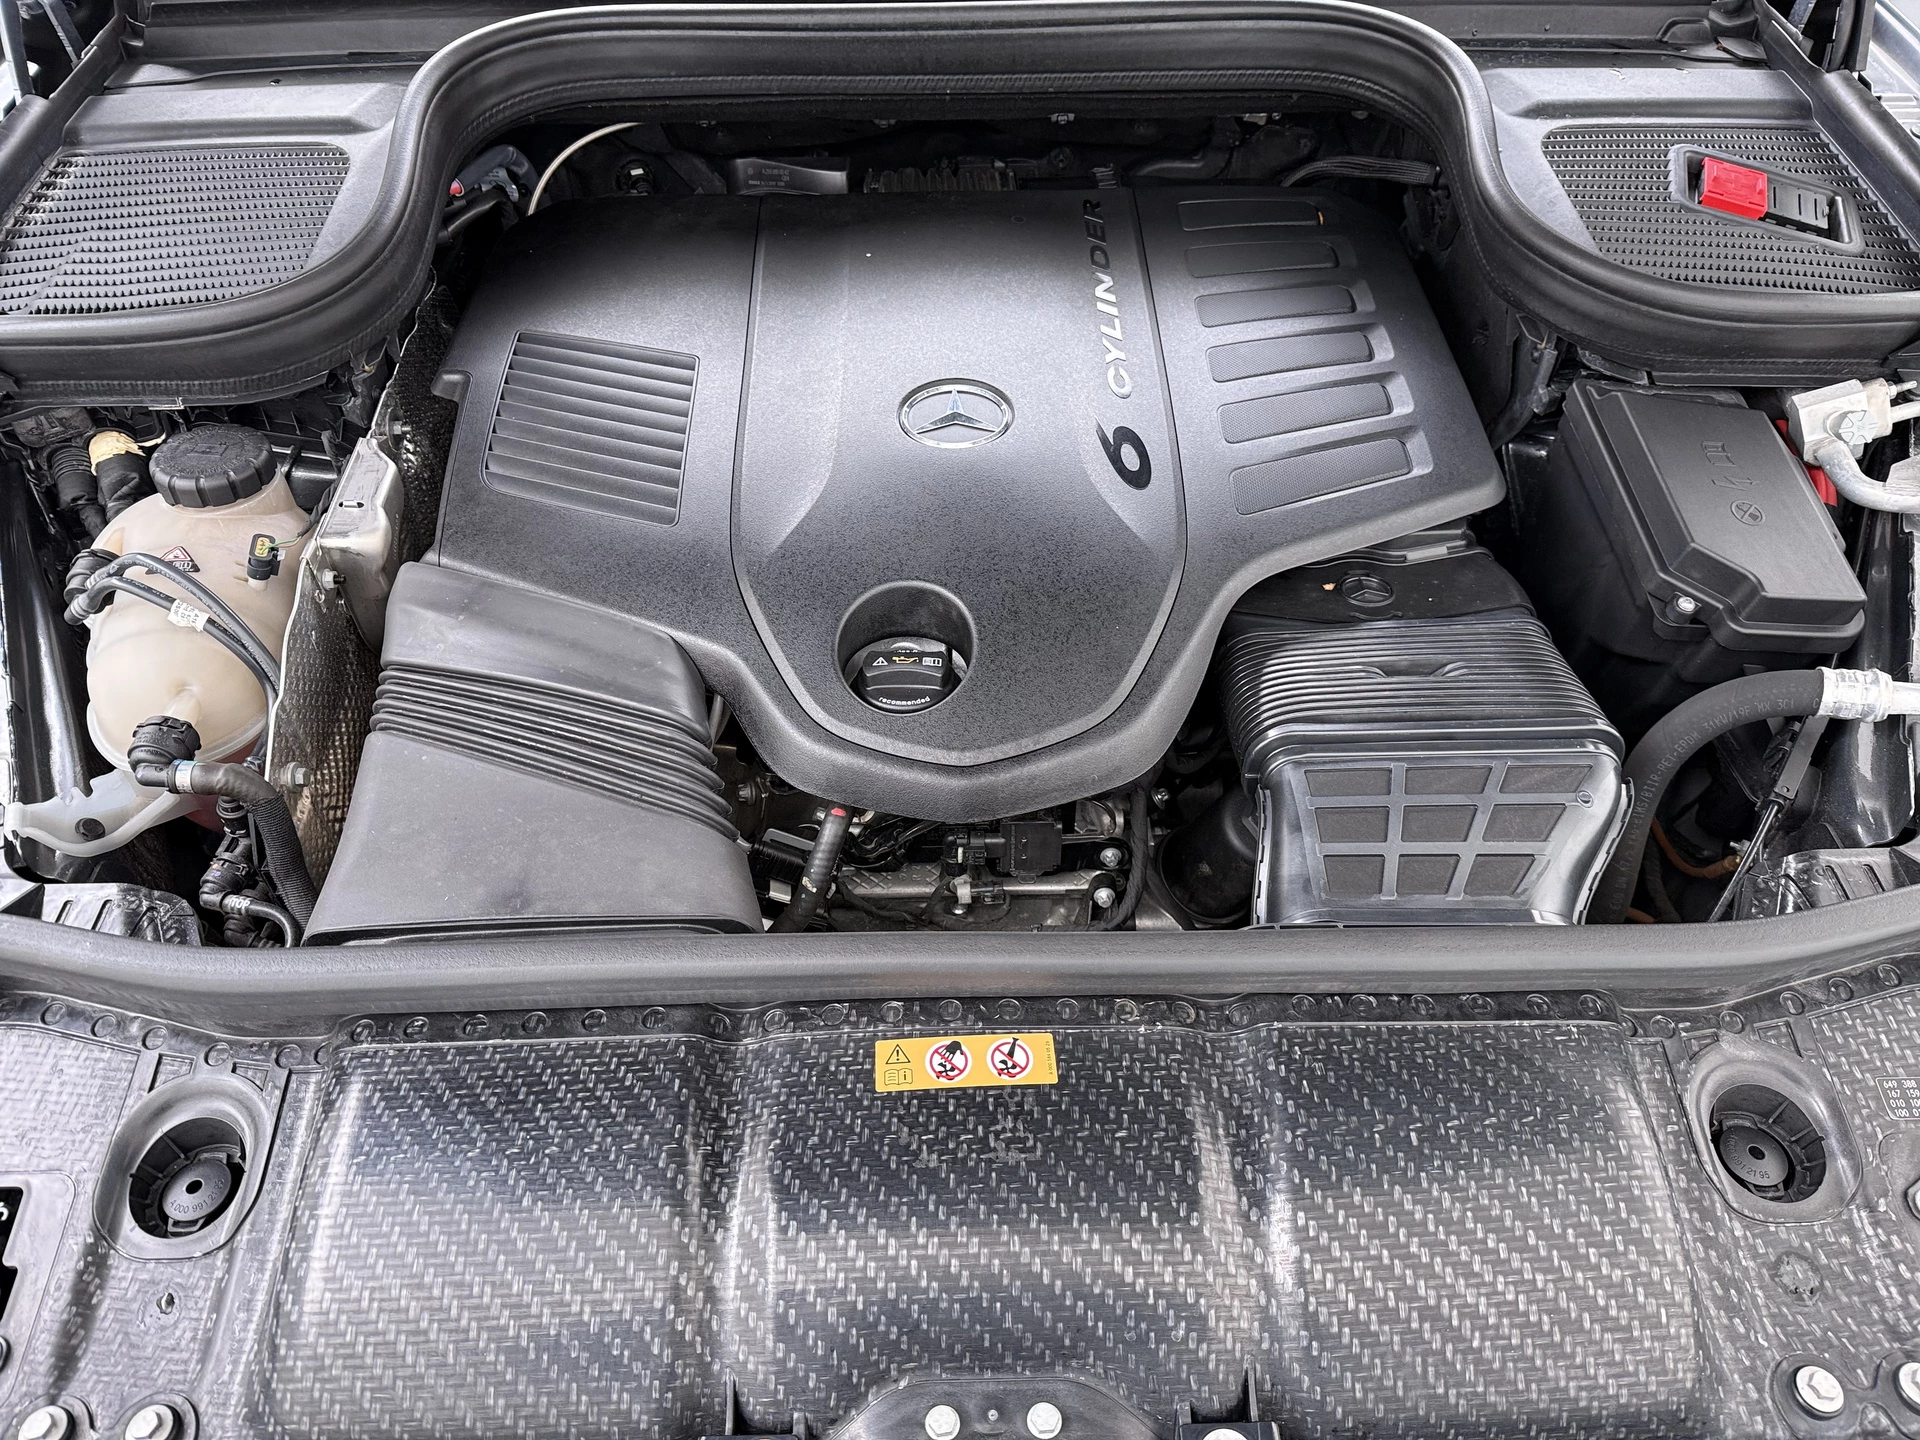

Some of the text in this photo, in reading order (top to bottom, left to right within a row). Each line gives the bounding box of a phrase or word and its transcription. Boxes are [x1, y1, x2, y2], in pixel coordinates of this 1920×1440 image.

[1083, 199, 1152, 490] 6 CYLINDER
[878, 695, 931, 706] recommended
[1883, 1079, 1917, 1089] 649 388
[1886, 1089, 1920, 1098] 167 159
[1889, 1098, 1920, 1108] 010 10
[1894, 1108, 1910, 1117] 100
[1730, 1153, 1746, 1170] 991
[192, 1200, 209, 1212] 991
